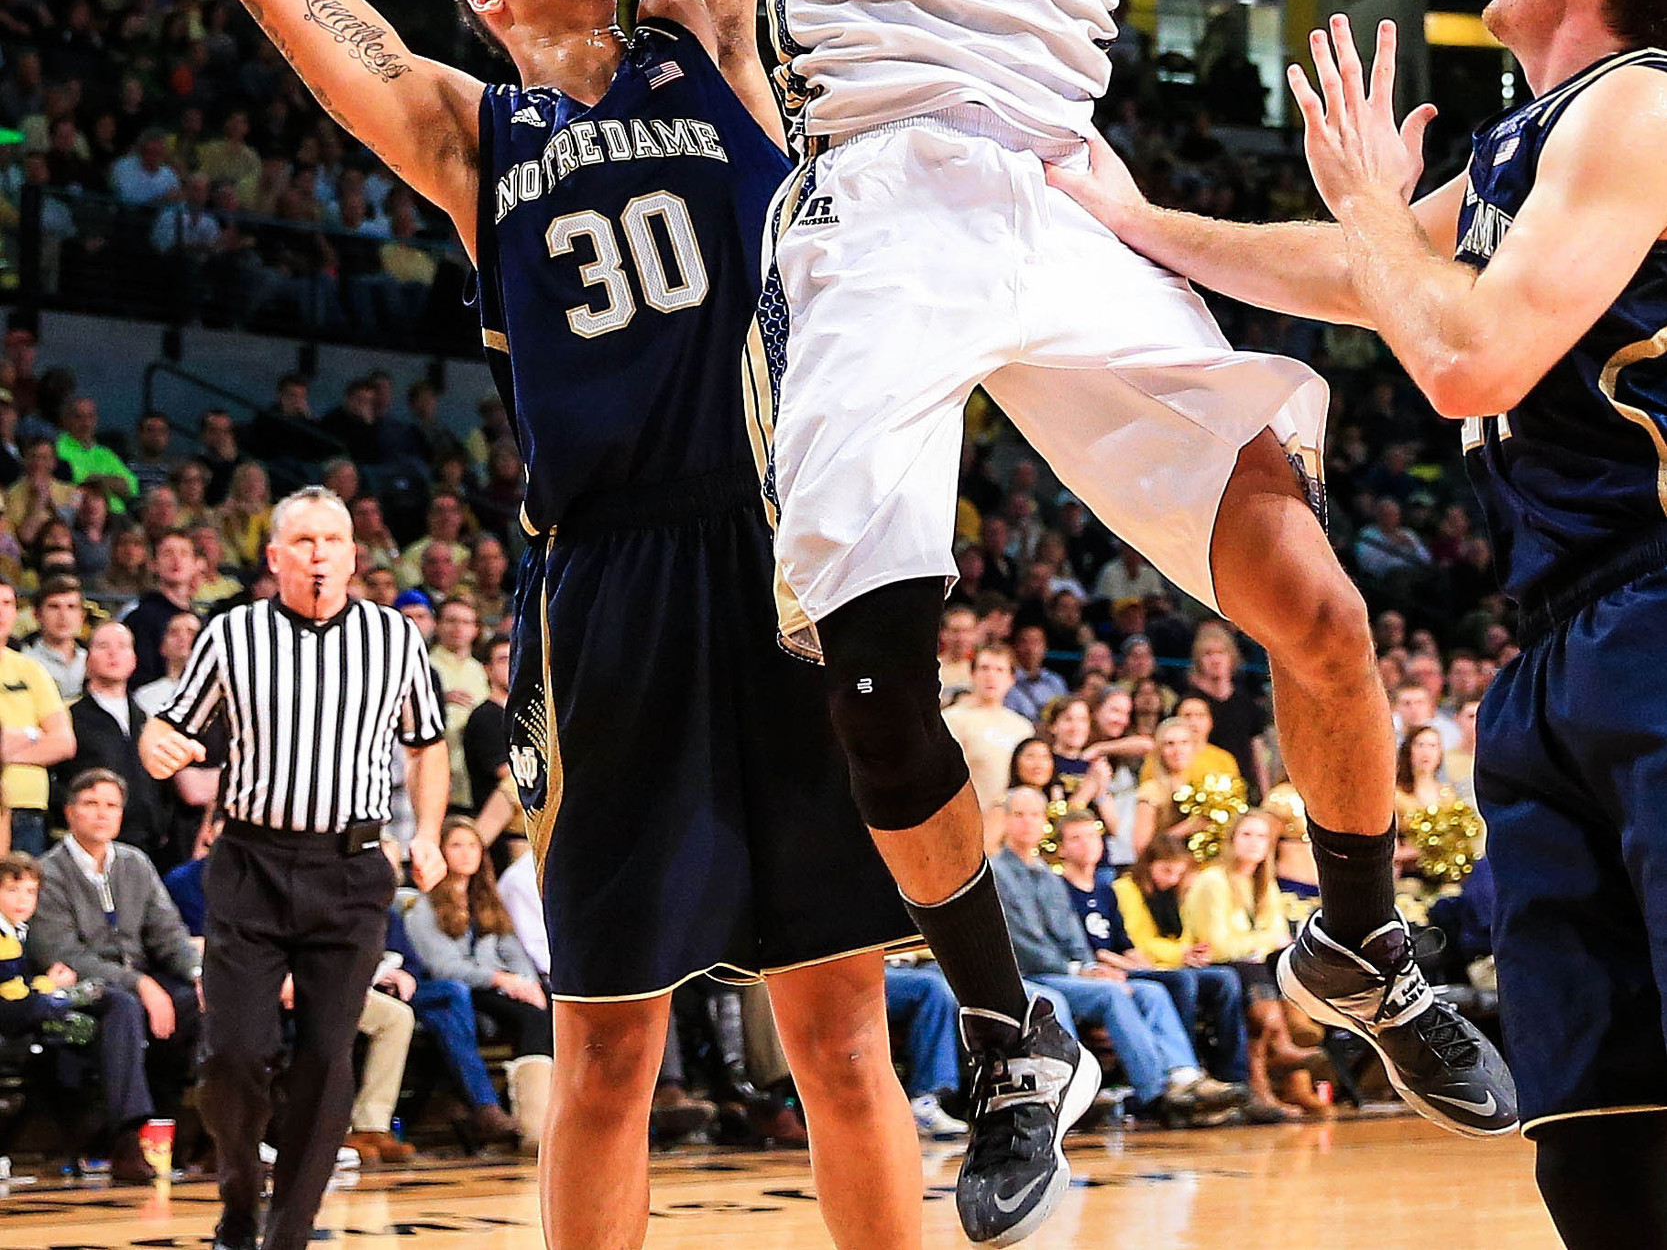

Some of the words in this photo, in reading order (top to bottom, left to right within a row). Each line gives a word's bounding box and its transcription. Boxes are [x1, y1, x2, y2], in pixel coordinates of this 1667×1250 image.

[495, 120, 604, 225] NOTRE
[602, 118, 729, 163] DAME
[545, 189, 710, 339] 30
